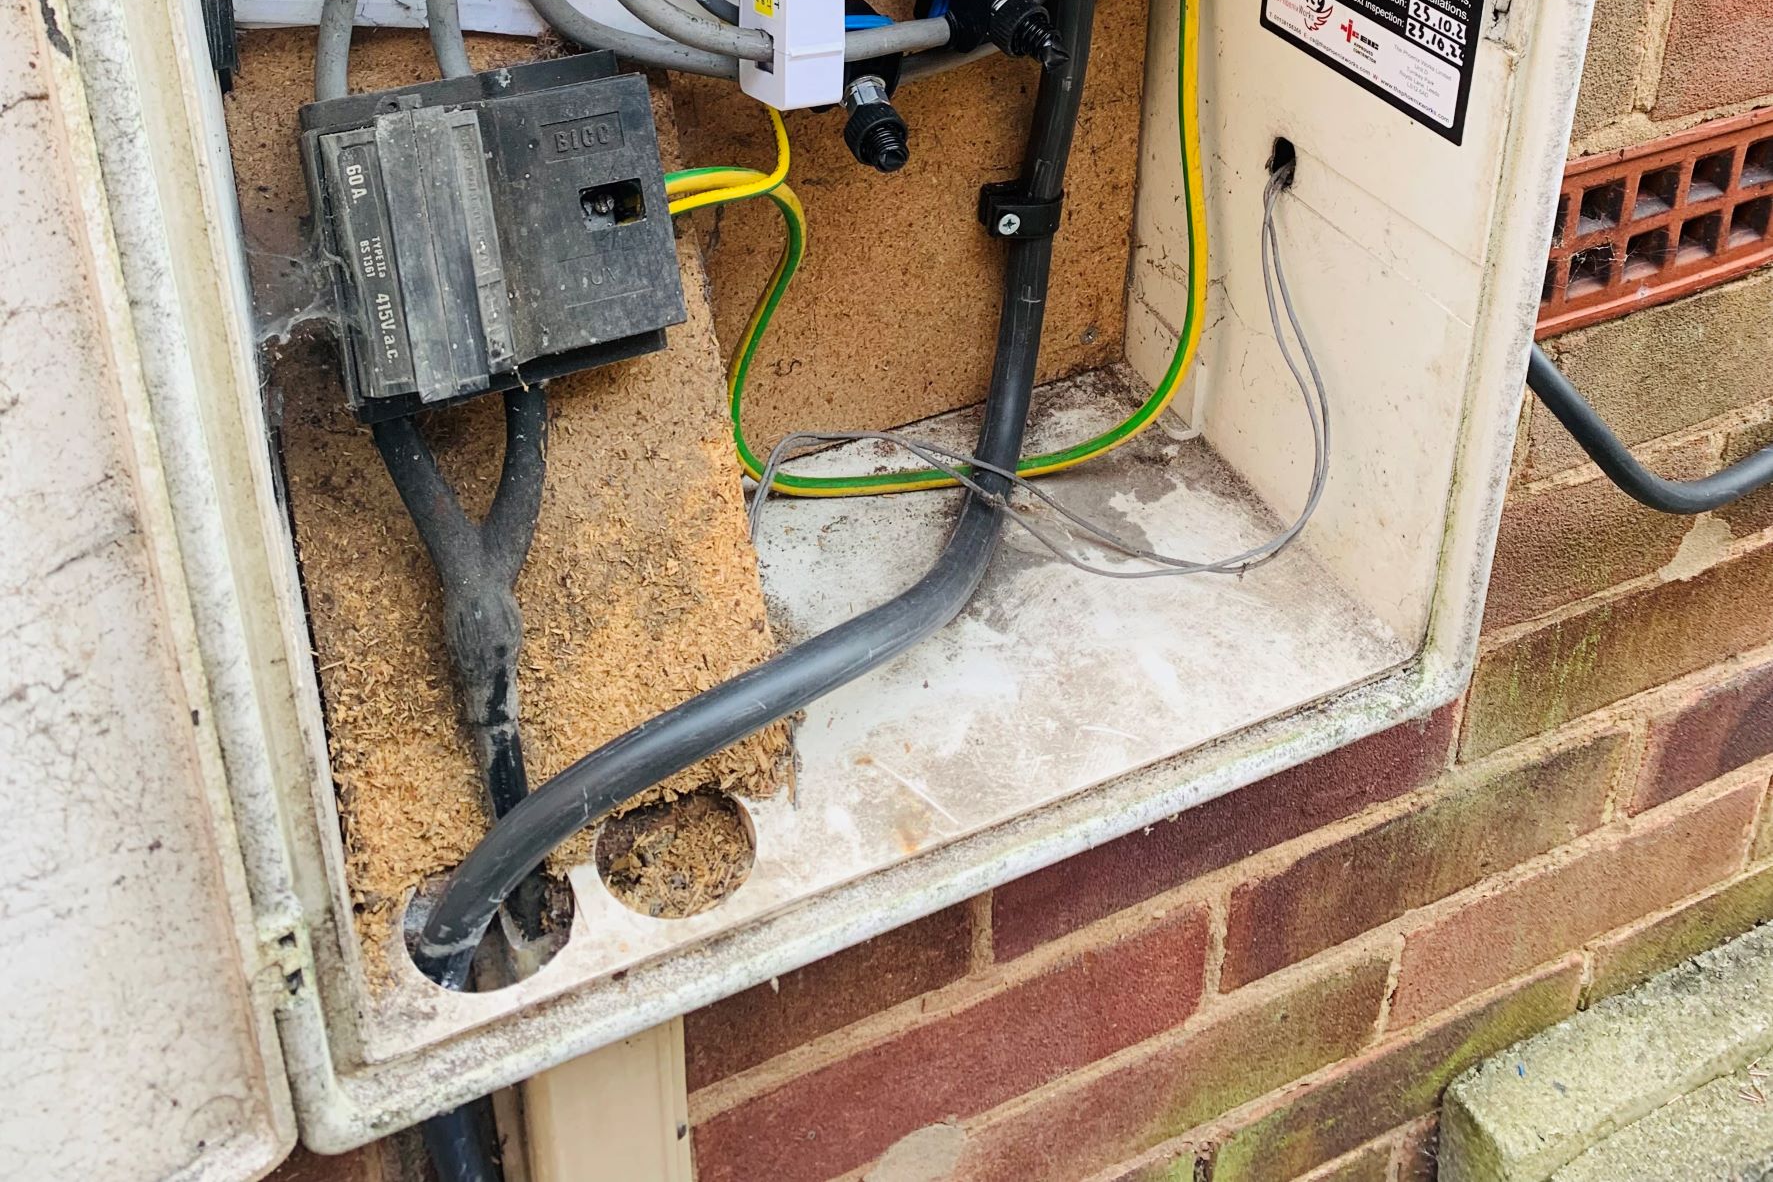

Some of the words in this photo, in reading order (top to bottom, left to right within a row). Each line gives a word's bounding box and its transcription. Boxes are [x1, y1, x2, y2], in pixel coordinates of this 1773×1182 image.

[554, 122, 609, 154] BICC
[359, 240, 372, 253] BS
[361, 254, 375, 278] 1361
